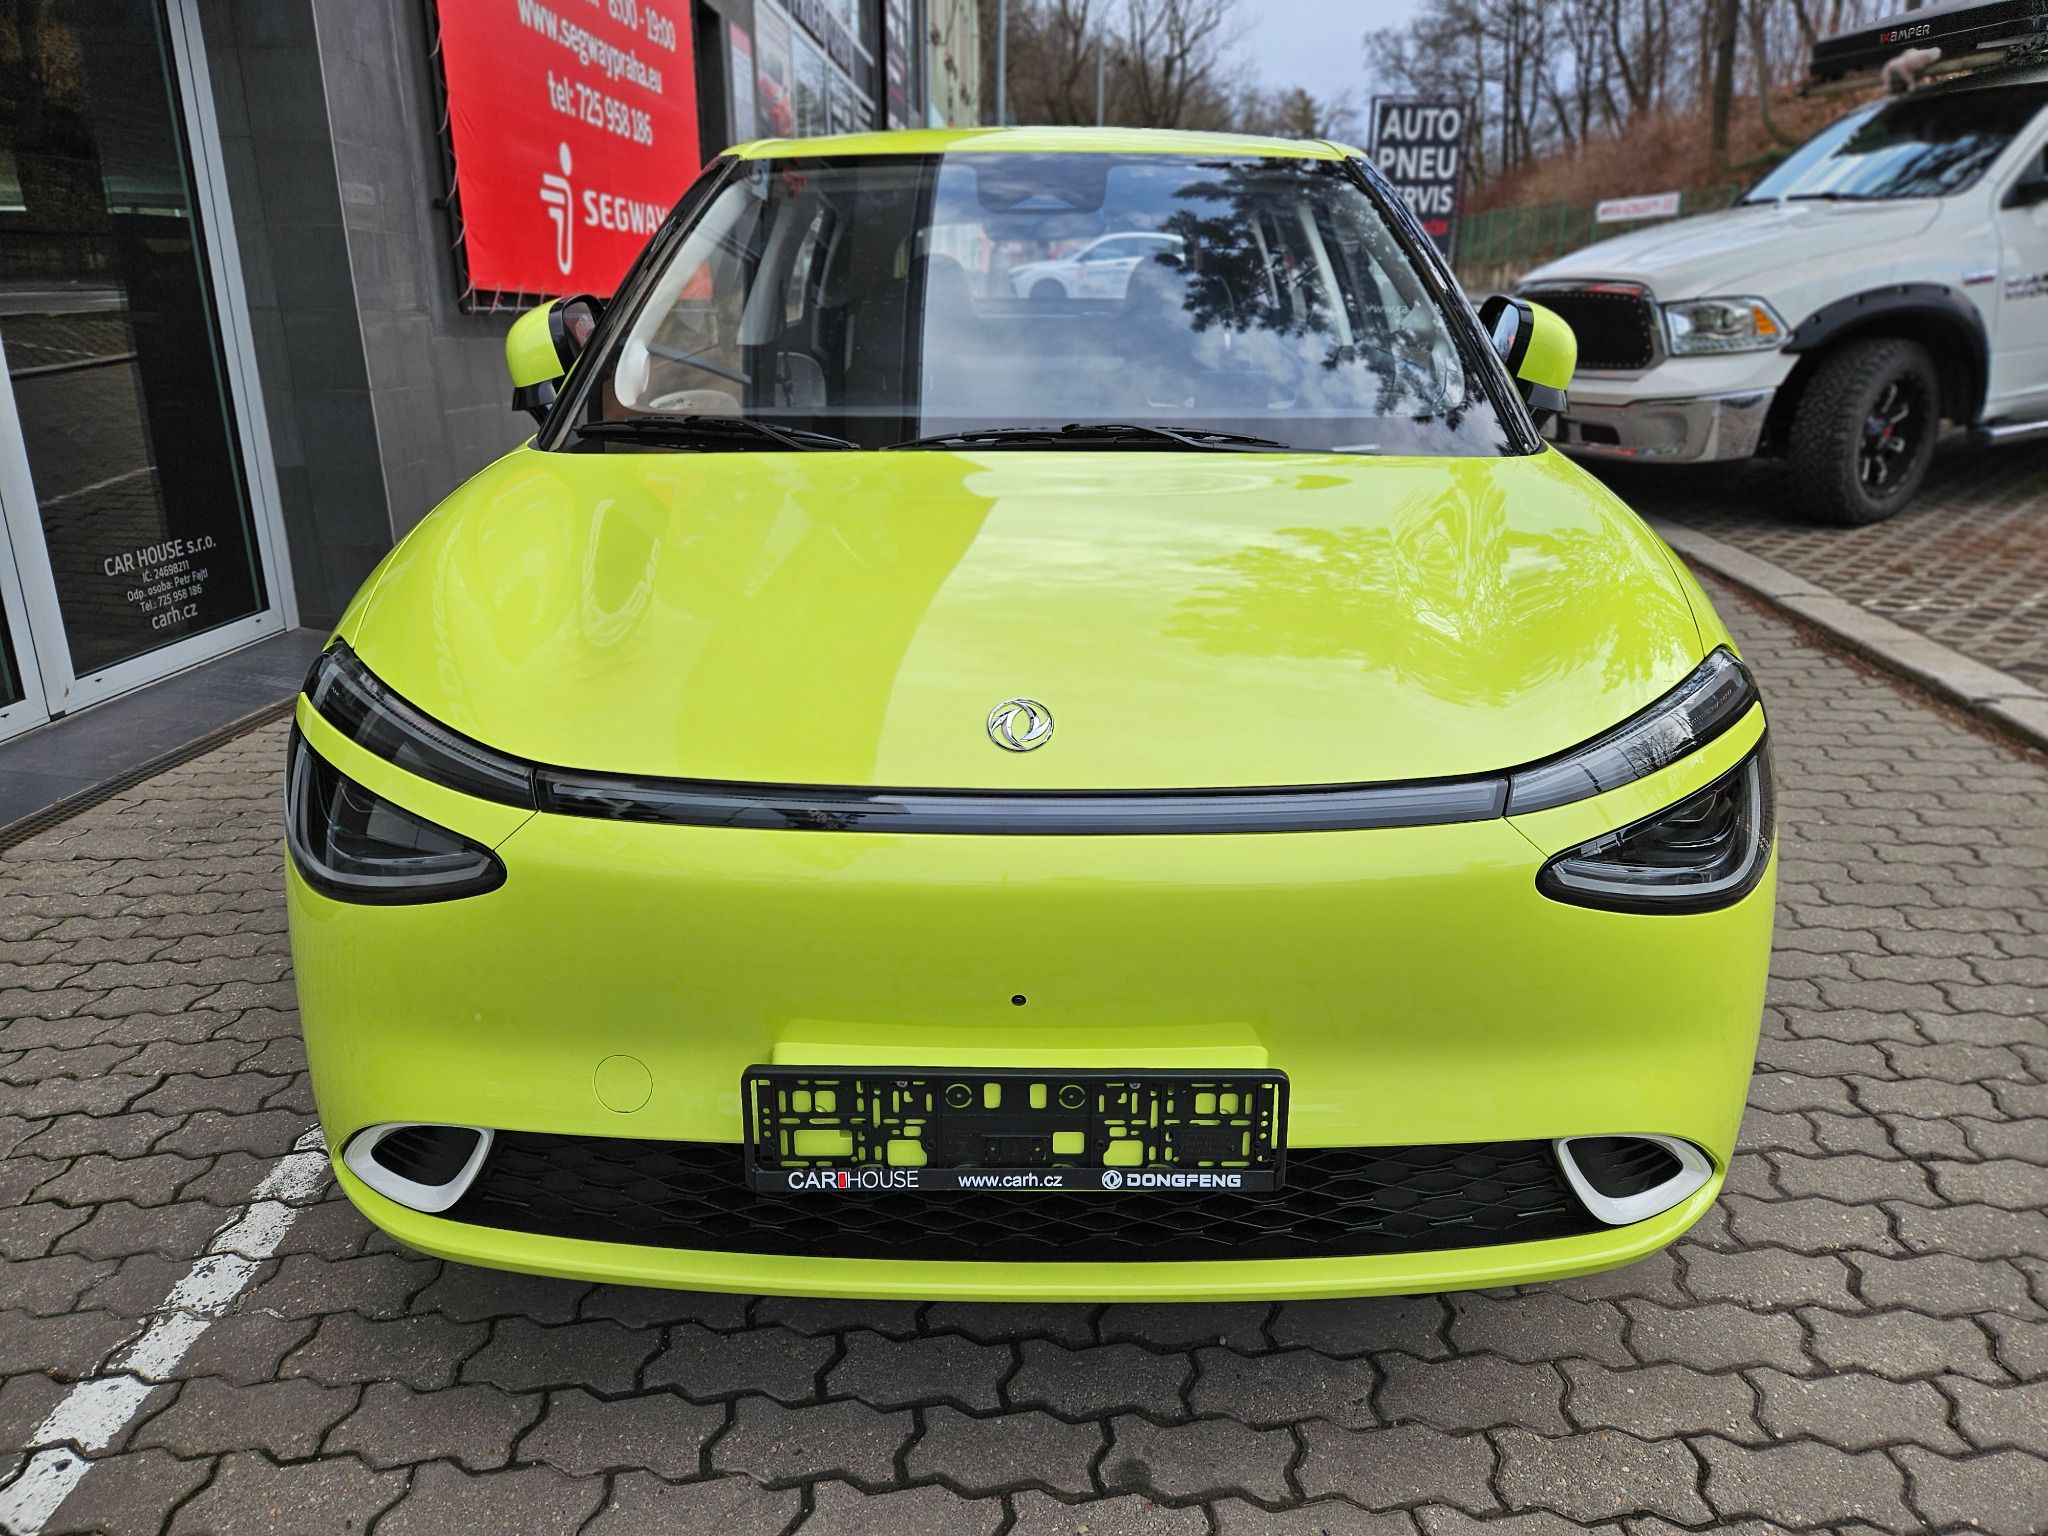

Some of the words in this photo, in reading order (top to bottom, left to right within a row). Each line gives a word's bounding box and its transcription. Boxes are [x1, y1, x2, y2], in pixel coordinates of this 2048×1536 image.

[517, 0, 663, 95] www.segwaypraha.eu
[548, 69, 576, 117] tel:
[576, 82, 604, 129] 725
[604, 96, 631, 139] 958
[631, 108, 653, 147] 186
[1382, 108, 1460, 141] AUTO
[1378, 147, 1457, 180] PNEU
[104, 553, 136, 577] CAR
[136, 539, 184, 568] HOUSE
[186, 535, 217, 554] s.r.o.
[154, 560, 190, 580] 24698211
[127, 588, 147, 603] Odp.
[148, 580, 174, 596] osoba:
[174, 574, 191, 588] Petr
[157, 593, 172, 608] 725
[172, 588, 188, 602] 958
[188, 583, 203, 596] 186
[152, 603, 198, 630] carh.cz
[958, 1172, 1063, 1188] www.carh.cz
[1126, 1173, 1242, 1188] DONGFENG
